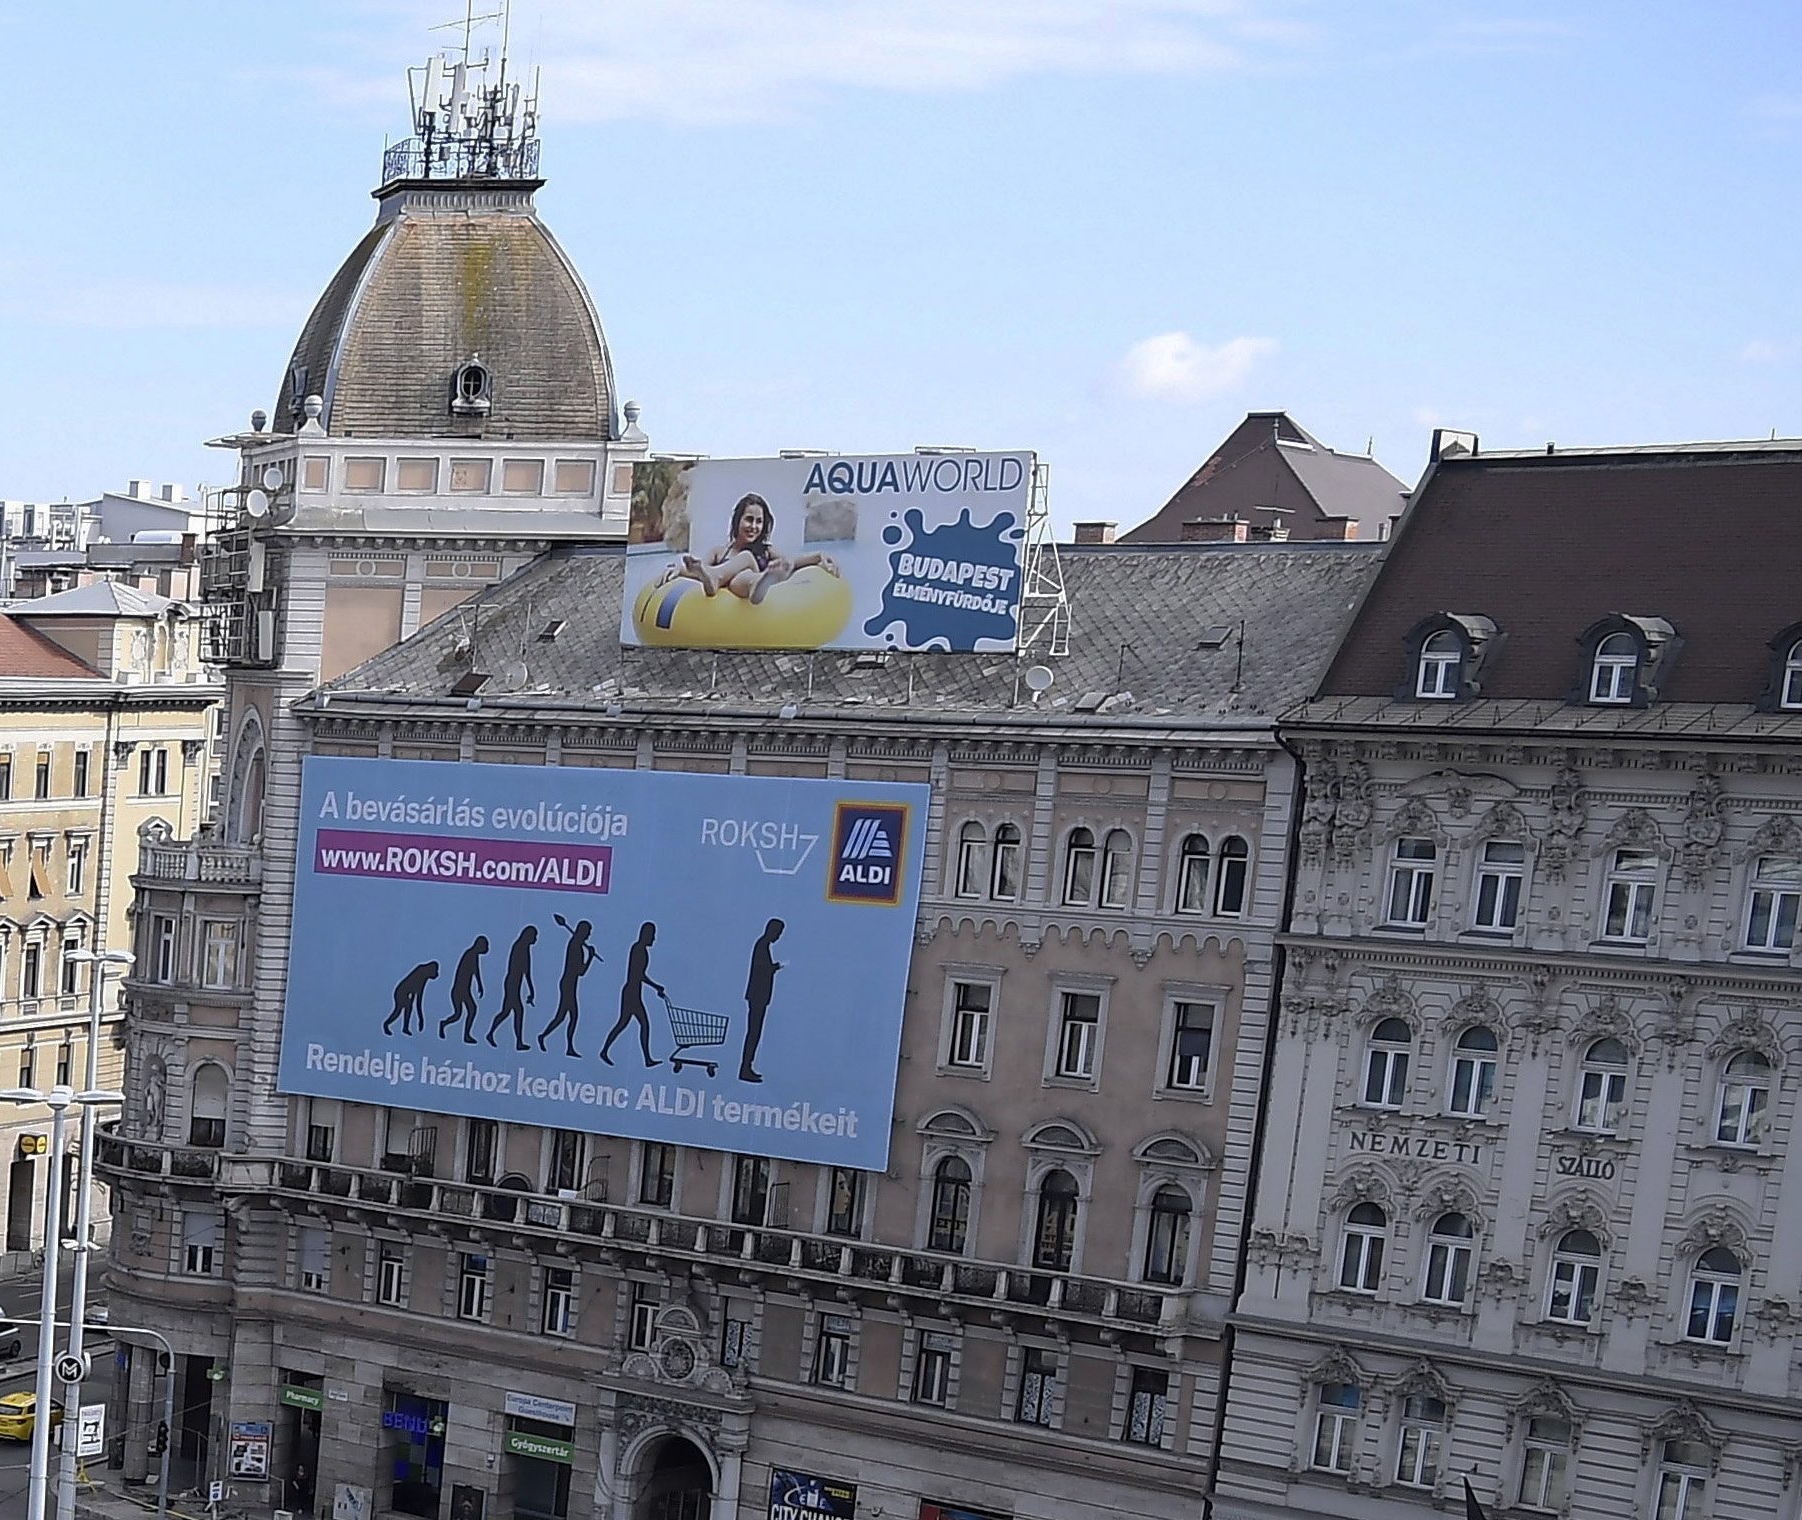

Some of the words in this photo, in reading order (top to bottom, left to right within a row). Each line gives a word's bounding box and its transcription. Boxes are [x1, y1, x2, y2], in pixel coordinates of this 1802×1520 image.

[803, 457, 1023, 495] AQUAWORLD
[897, 552, 1015, 592] BUDAPEST
[892, 577, 1009, 616] ÉLMÉNYFÜRDŐJE
[319, 790, 339, 819] A
[346, 791, 485, 827] bevásárlás
[491, 801, 628, 841] evolúciója
[700, 818, 799, 850] ROKSH
[321, 846, 603, 887] www.ROKSH.com/ALDI
[838, 863, 892, 885] ALDI
[305, 1042, 416, 1087] Rendelje
[420, 1054, 511, 1094] házhoz
[516, 1066, 630, 1109] kedvenc
[635, 1082, 705, 1120] ALDI
[712, 1094, 859, 1139] termékeit
